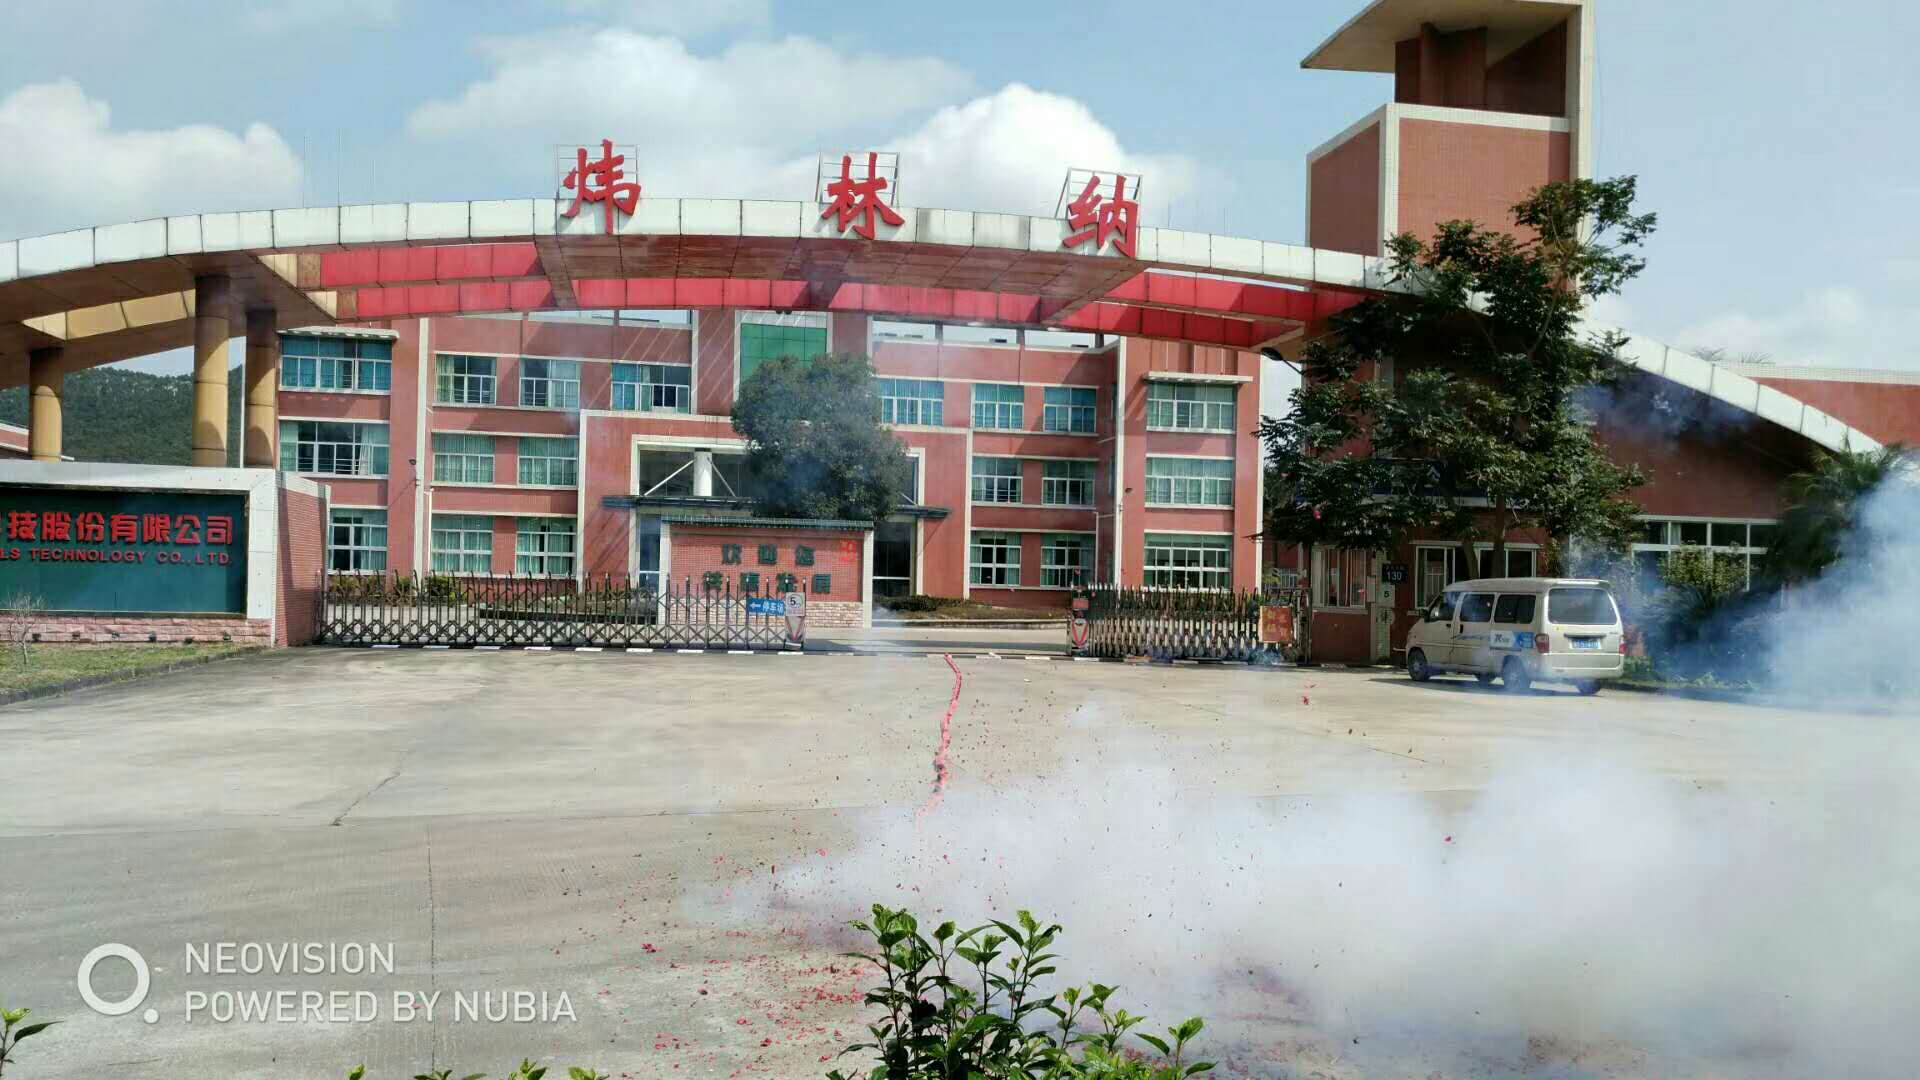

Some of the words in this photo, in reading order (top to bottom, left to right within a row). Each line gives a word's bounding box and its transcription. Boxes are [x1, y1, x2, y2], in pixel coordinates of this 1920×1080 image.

[559, 138, 1139, 259] 炜林纳
[0, 510, 233, 545] 技股份有限公司
[30, 547, 146, 564] TECHNOLOGY
